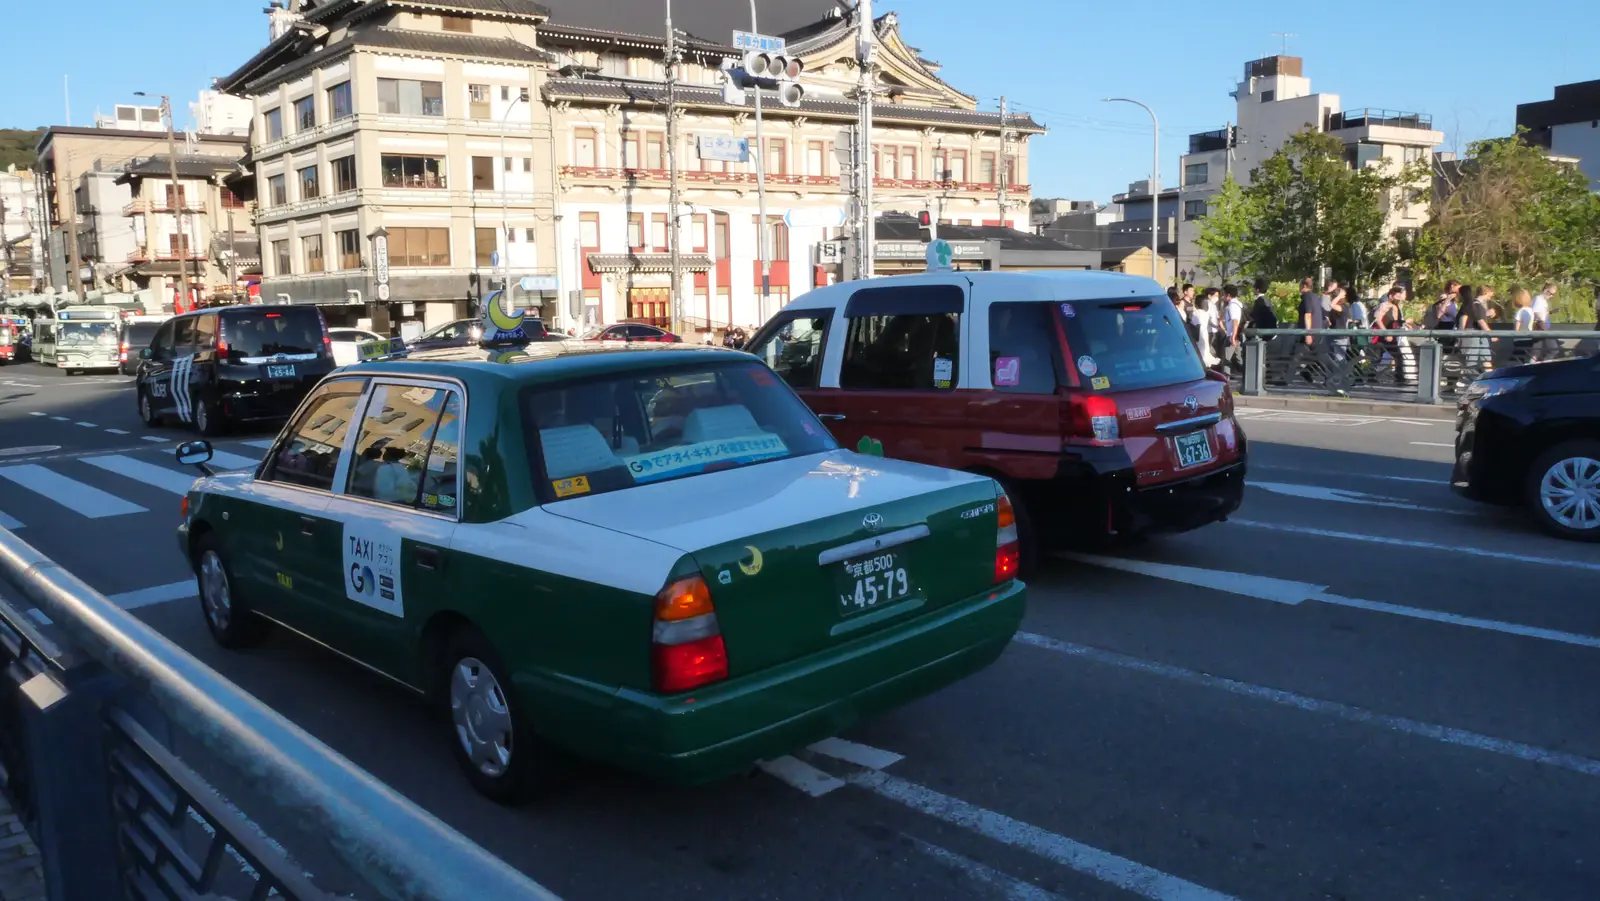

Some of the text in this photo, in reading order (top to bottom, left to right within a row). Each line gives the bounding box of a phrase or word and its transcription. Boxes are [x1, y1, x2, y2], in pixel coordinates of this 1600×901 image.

[151, 379, 167, 397] Uber
[350, 535, 374, 562] TAXI
[853, 554, 893, 577] 京都500
[276, 571, 293, 589] TAXI
[854, 568, 908, 607] 45-79
